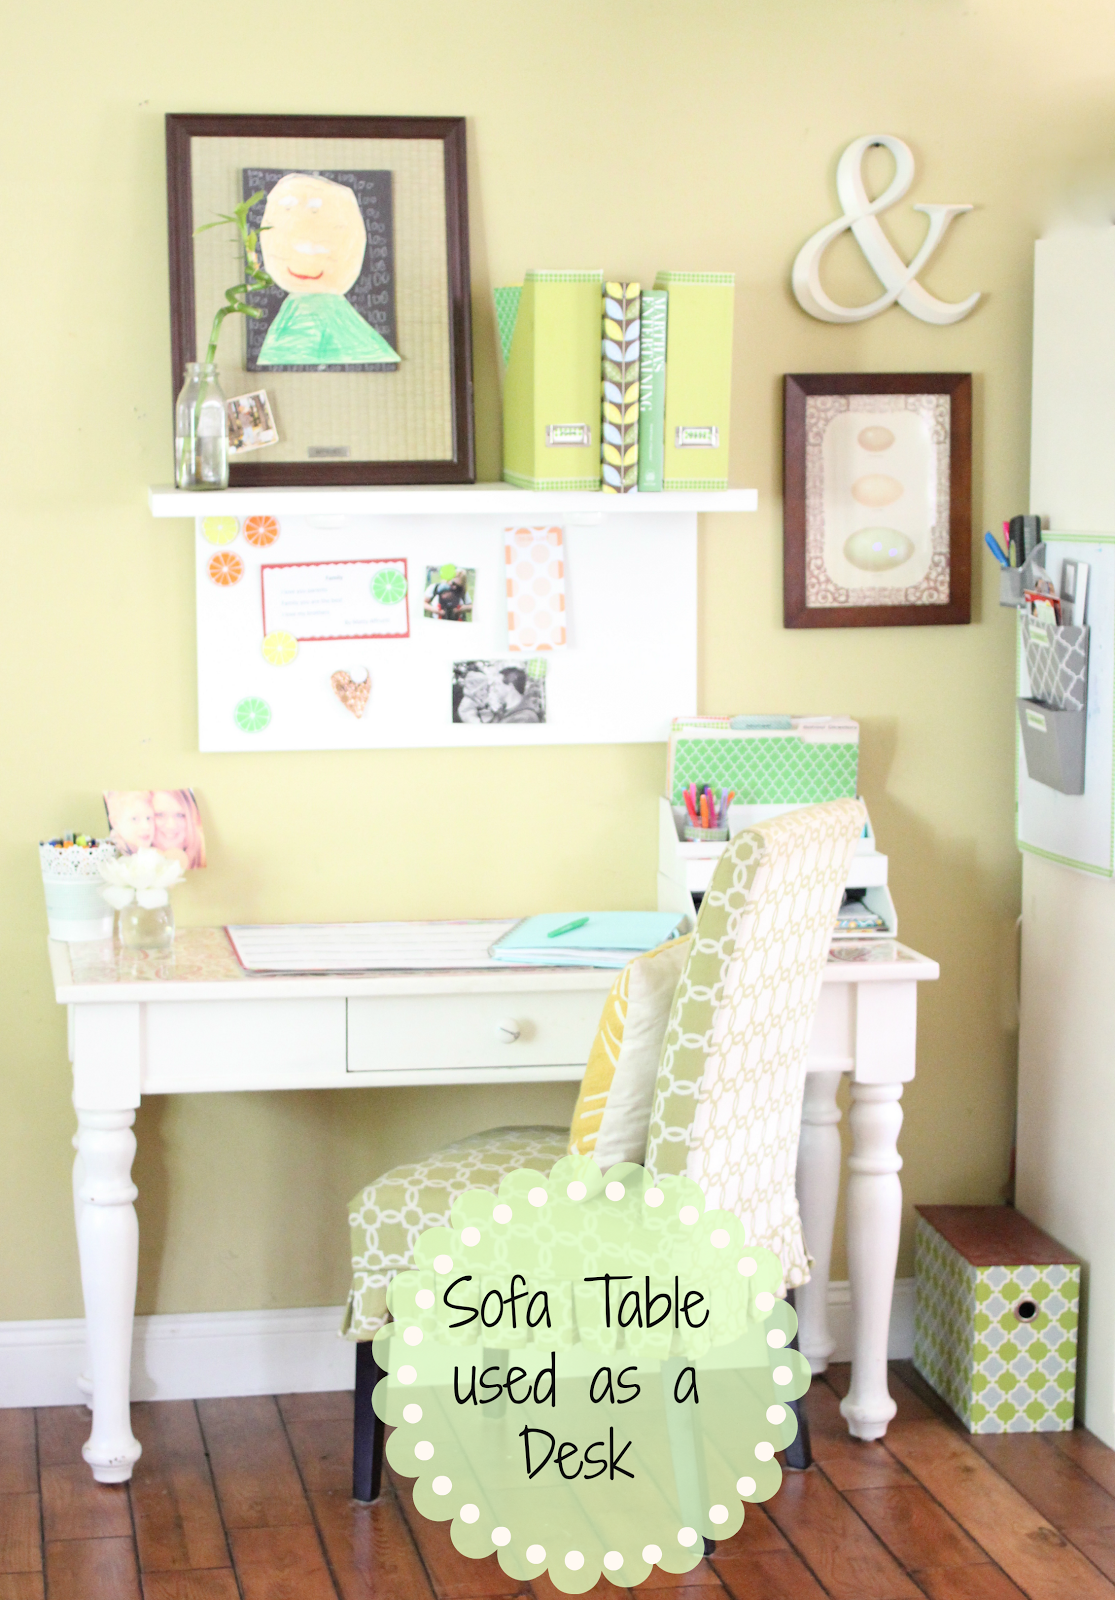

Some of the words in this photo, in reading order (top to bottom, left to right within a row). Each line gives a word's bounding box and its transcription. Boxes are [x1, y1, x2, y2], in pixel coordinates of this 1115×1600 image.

[366, 219, 386, 233] 100
[367, 233, 387, 245] 100
[367, 290, 389, 307] 100
[368, 309, 387, 323] 100
[640, 296, 654, 412] ENTERTAINING
